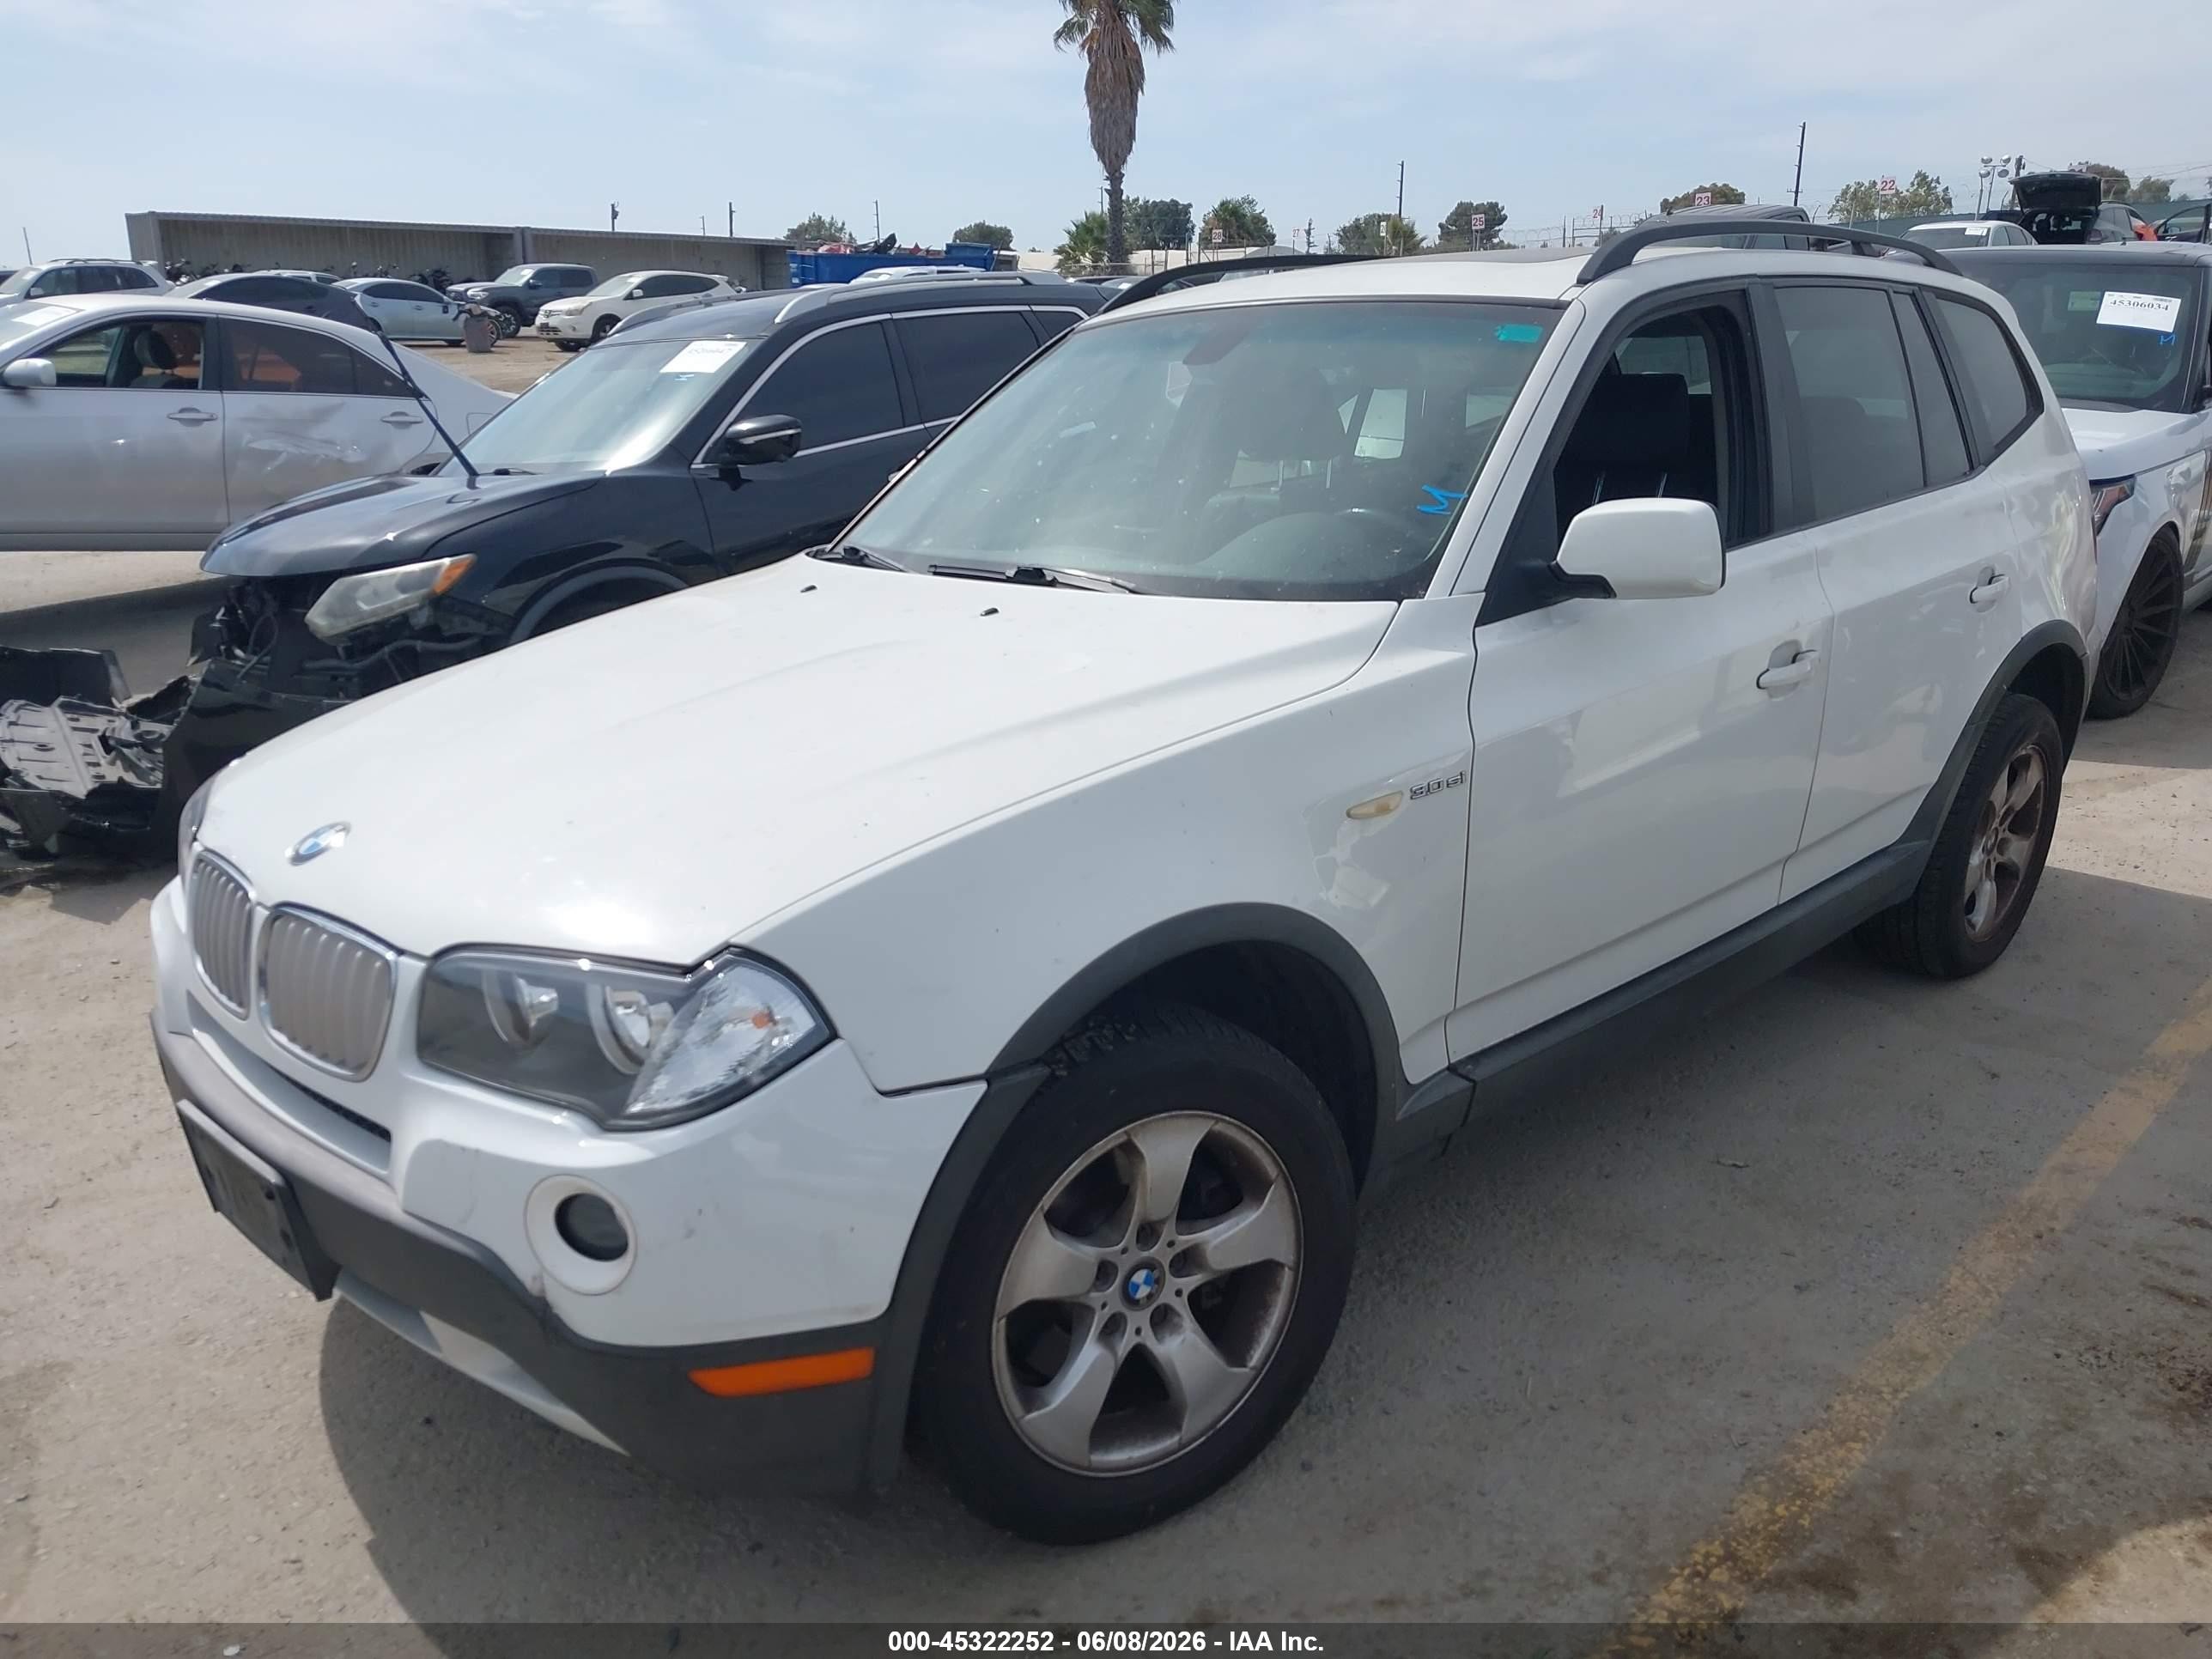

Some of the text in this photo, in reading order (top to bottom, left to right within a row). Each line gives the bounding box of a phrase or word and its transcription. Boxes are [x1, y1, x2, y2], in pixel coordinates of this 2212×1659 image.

[1881, 179, 1895, 191] 22
[1696, 196, 1711, 206] 23
[1473, 216, 1484, 227] 25
[1212, 232, 1222, 240] 28
[2110, 299, 2170, 311] 45306034
